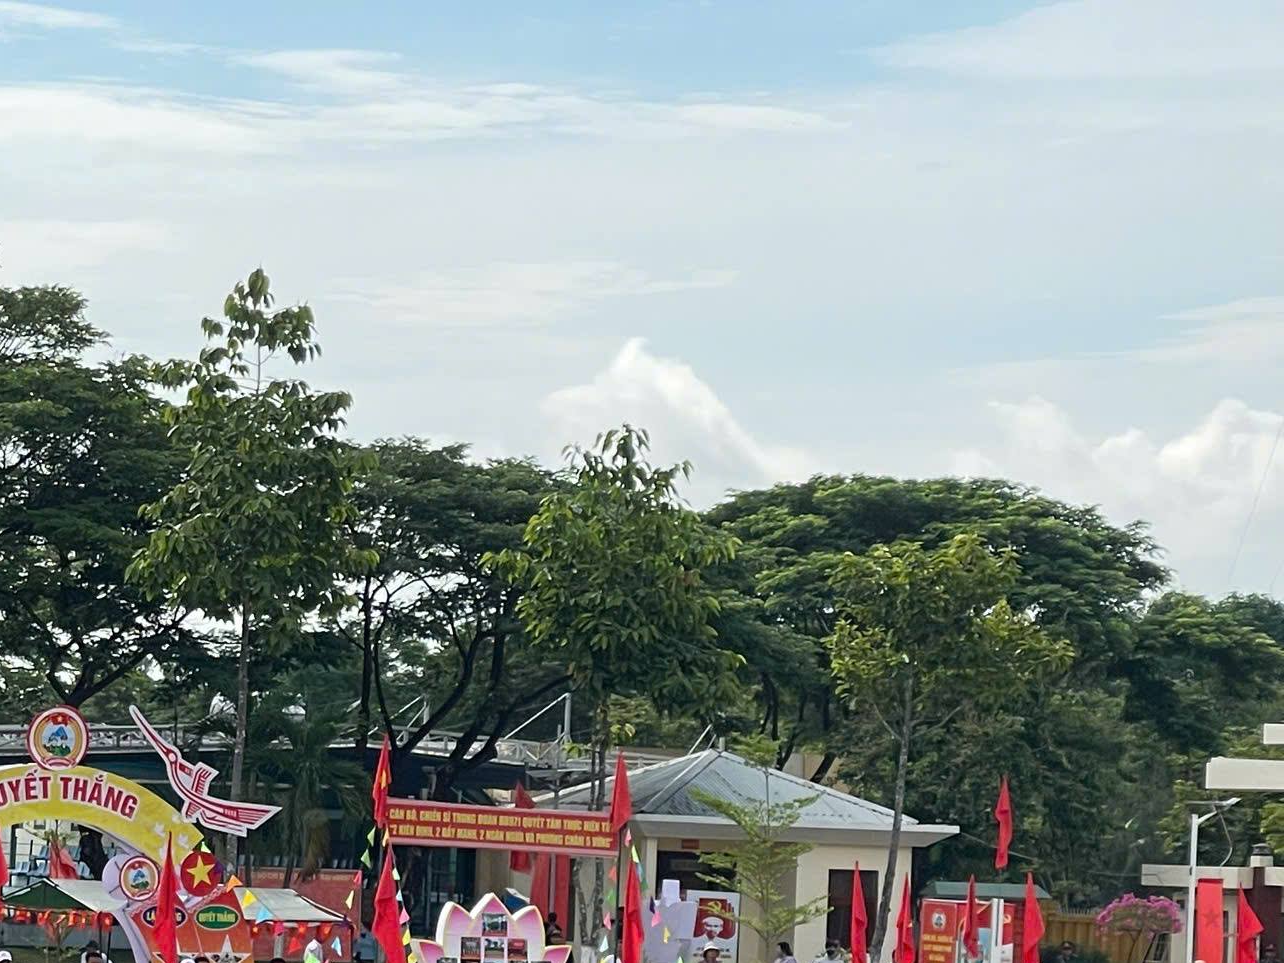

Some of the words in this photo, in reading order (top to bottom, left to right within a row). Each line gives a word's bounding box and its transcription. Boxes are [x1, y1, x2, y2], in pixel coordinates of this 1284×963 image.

[60, 774, 138, 819] THẮNG
[436, 827, 440, 837] 2
[480, 830, 484, 840] 2
